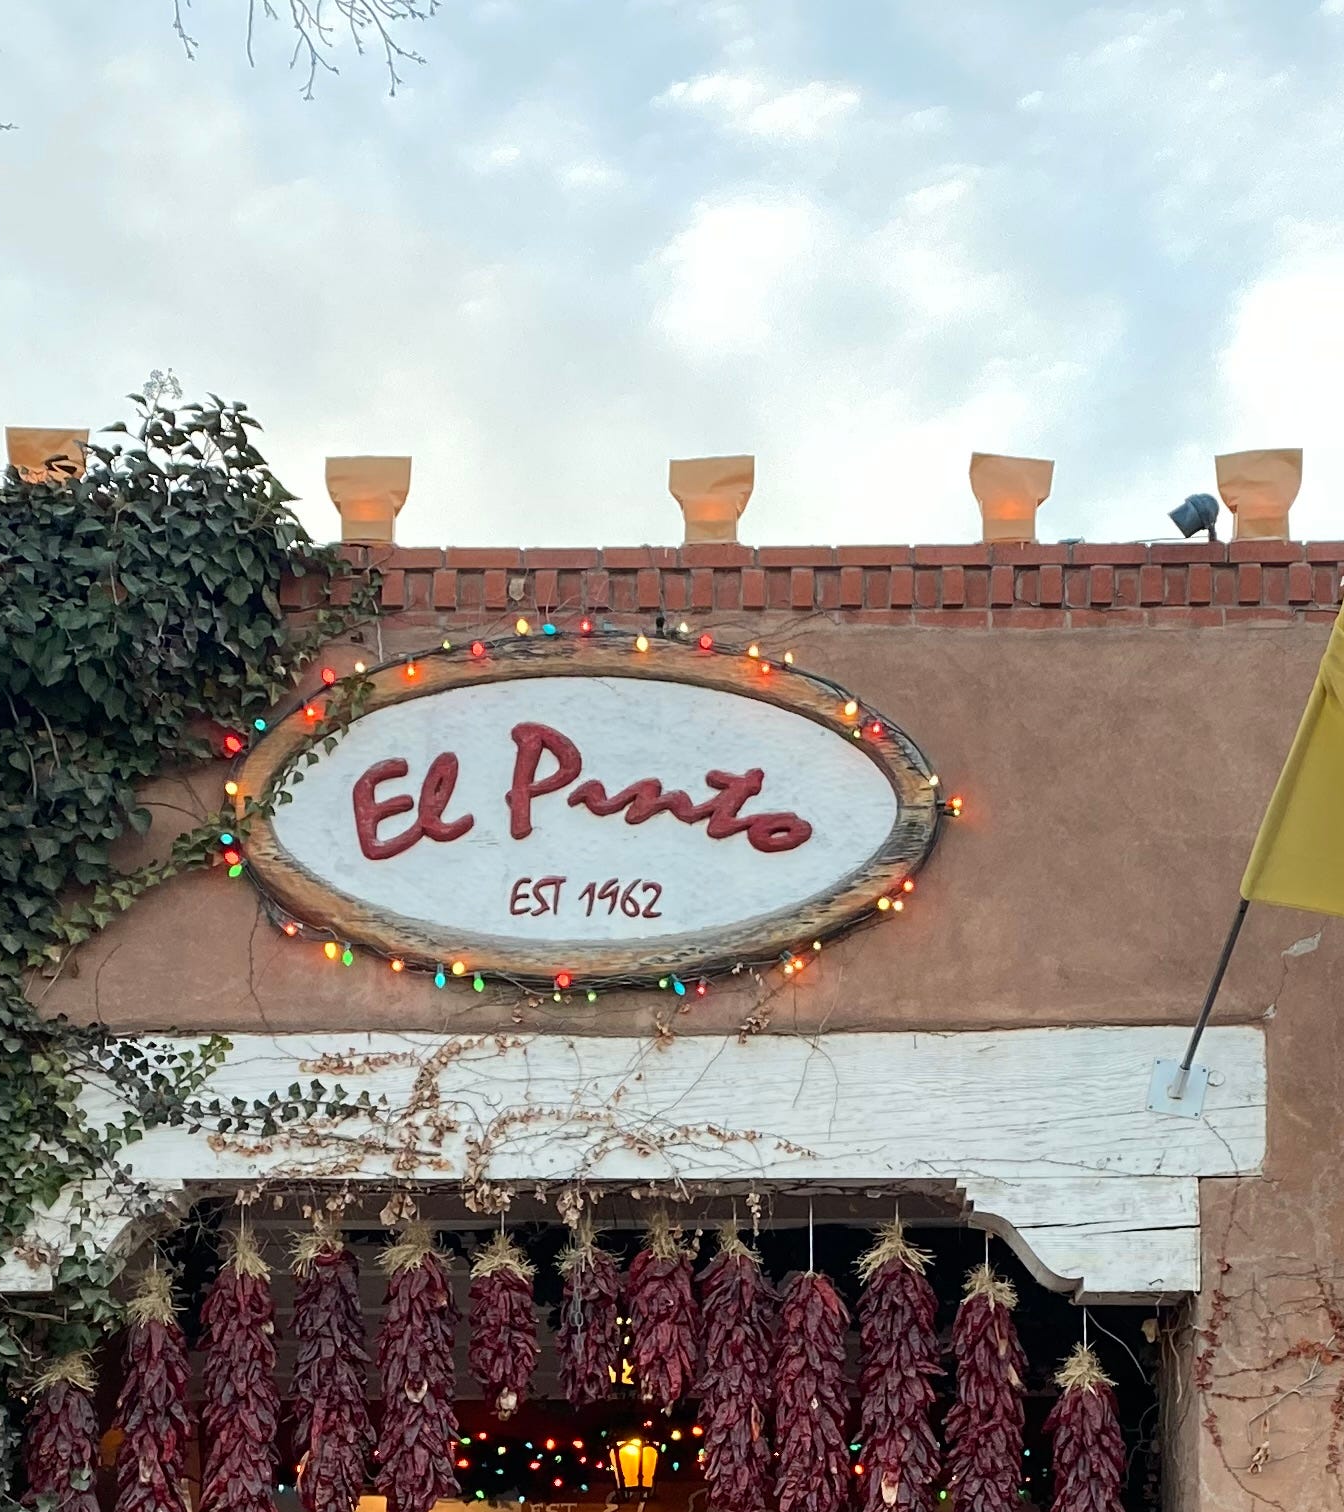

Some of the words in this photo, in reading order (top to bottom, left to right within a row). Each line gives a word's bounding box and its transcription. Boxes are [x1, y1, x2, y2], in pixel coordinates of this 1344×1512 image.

[352, 751, 475, 861] El
[504, 721, 814, 854] Pinto
[509, 875, 567, 916] EST
[578, 877, 663, 919] 1962
